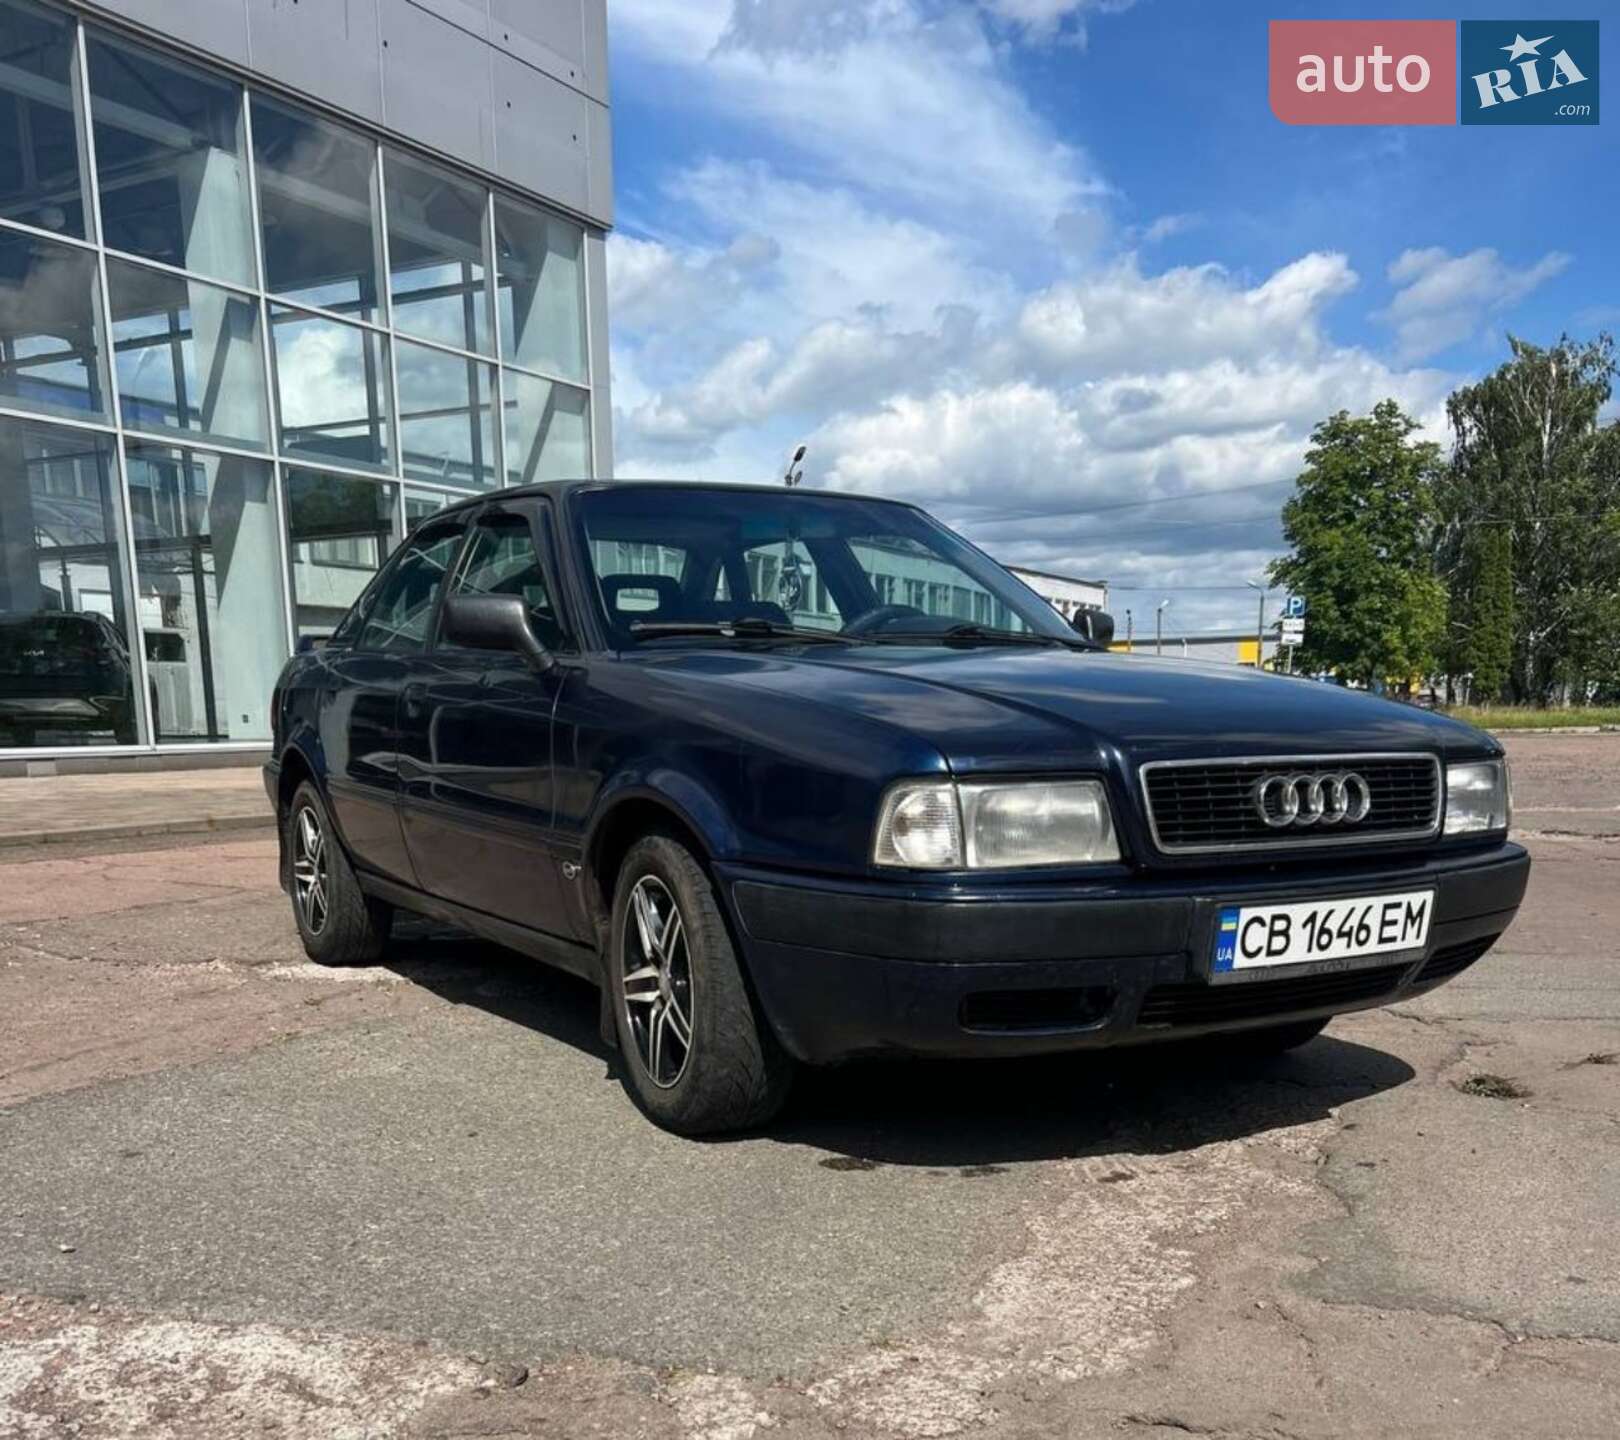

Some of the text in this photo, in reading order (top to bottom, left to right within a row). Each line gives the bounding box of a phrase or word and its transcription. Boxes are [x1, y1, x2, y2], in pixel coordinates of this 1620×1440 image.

[1290, 596, 1302, 616] P
[1240, 899, 1427, 959] CB 1646 EM
[1216, 946, 1233, 961] UA
